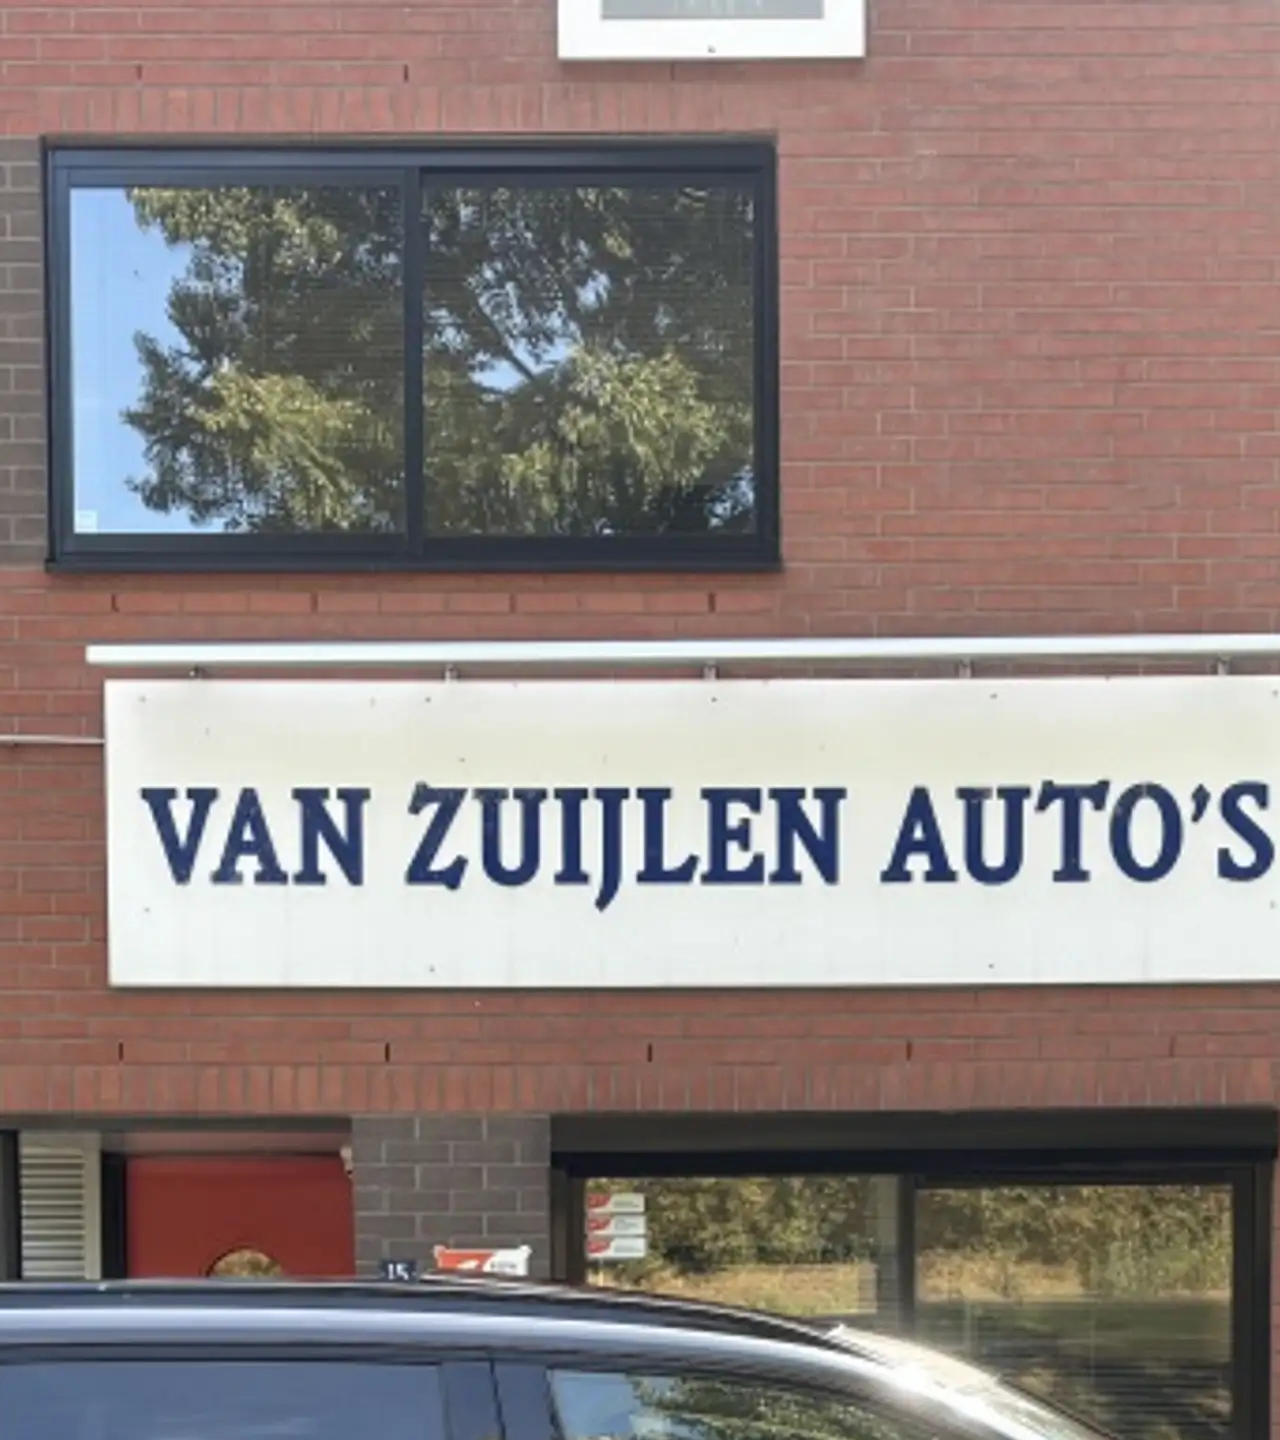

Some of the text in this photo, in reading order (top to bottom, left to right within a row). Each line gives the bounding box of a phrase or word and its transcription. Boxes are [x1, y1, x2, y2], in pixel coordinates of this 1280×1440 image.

[141, 780, 1276, 912] VAN ZUIJLEN AUTO'S
